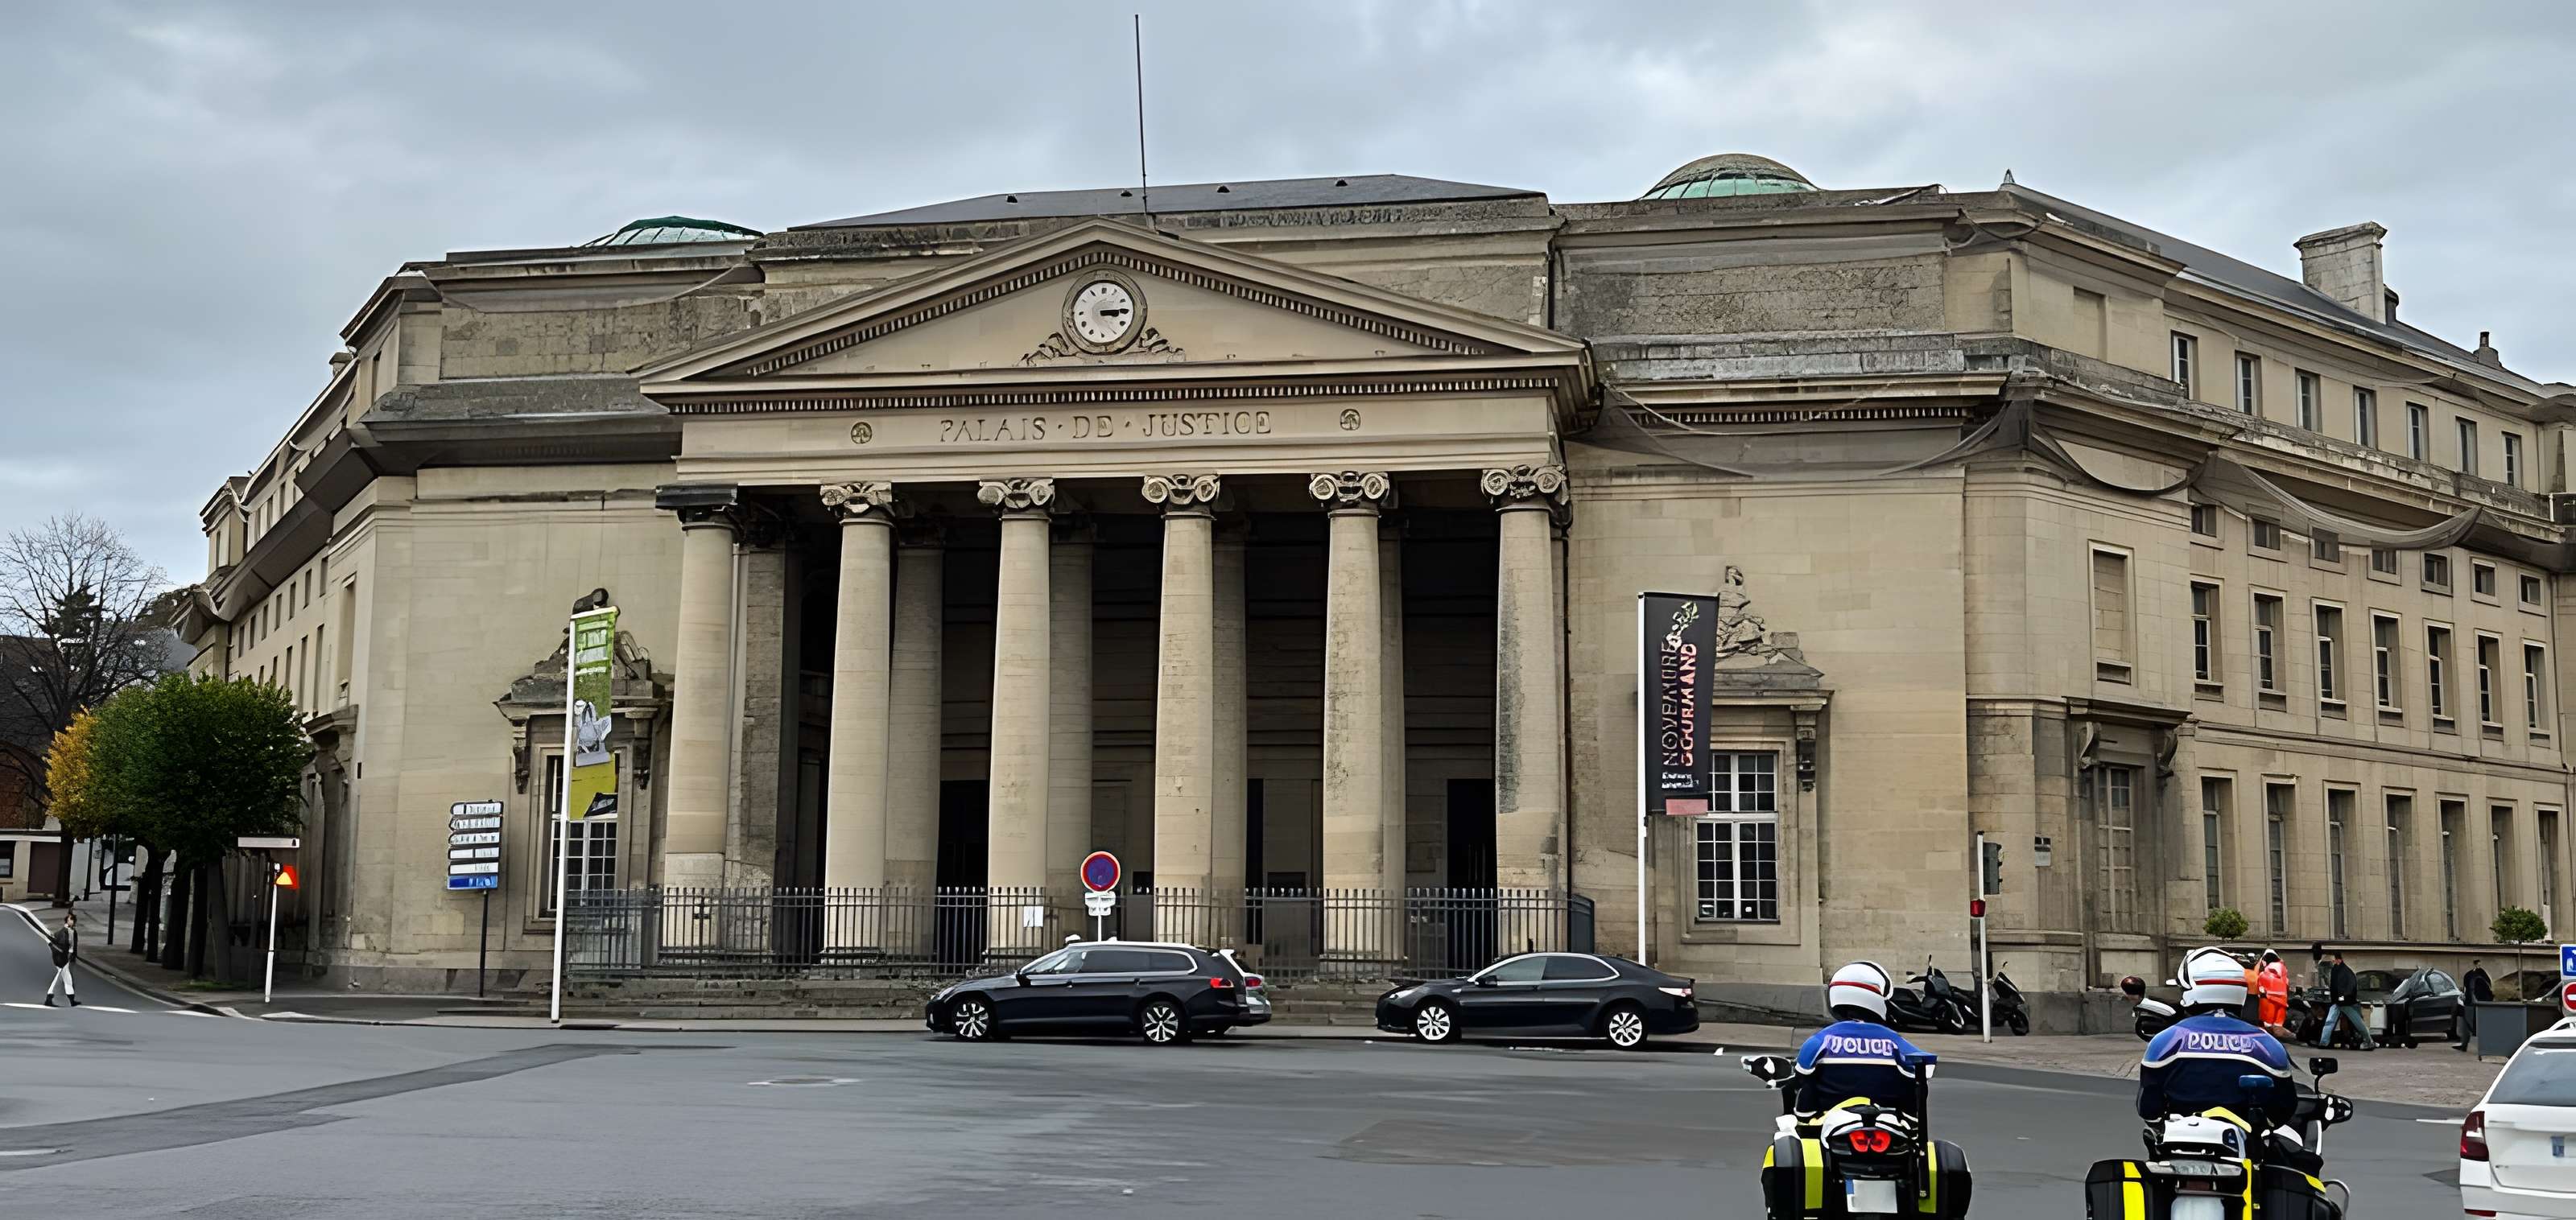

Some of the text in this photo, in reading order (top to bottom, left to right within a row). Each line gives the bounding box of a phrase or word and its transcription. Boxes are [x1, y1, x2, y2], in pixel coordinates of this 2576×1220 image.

[940, 411, 1273, 442] PALAIS DE JUSTICE
[1826, 1035, 1893, 1056] POLICE
[2187, 1032, 2254, 1053] POLICE
